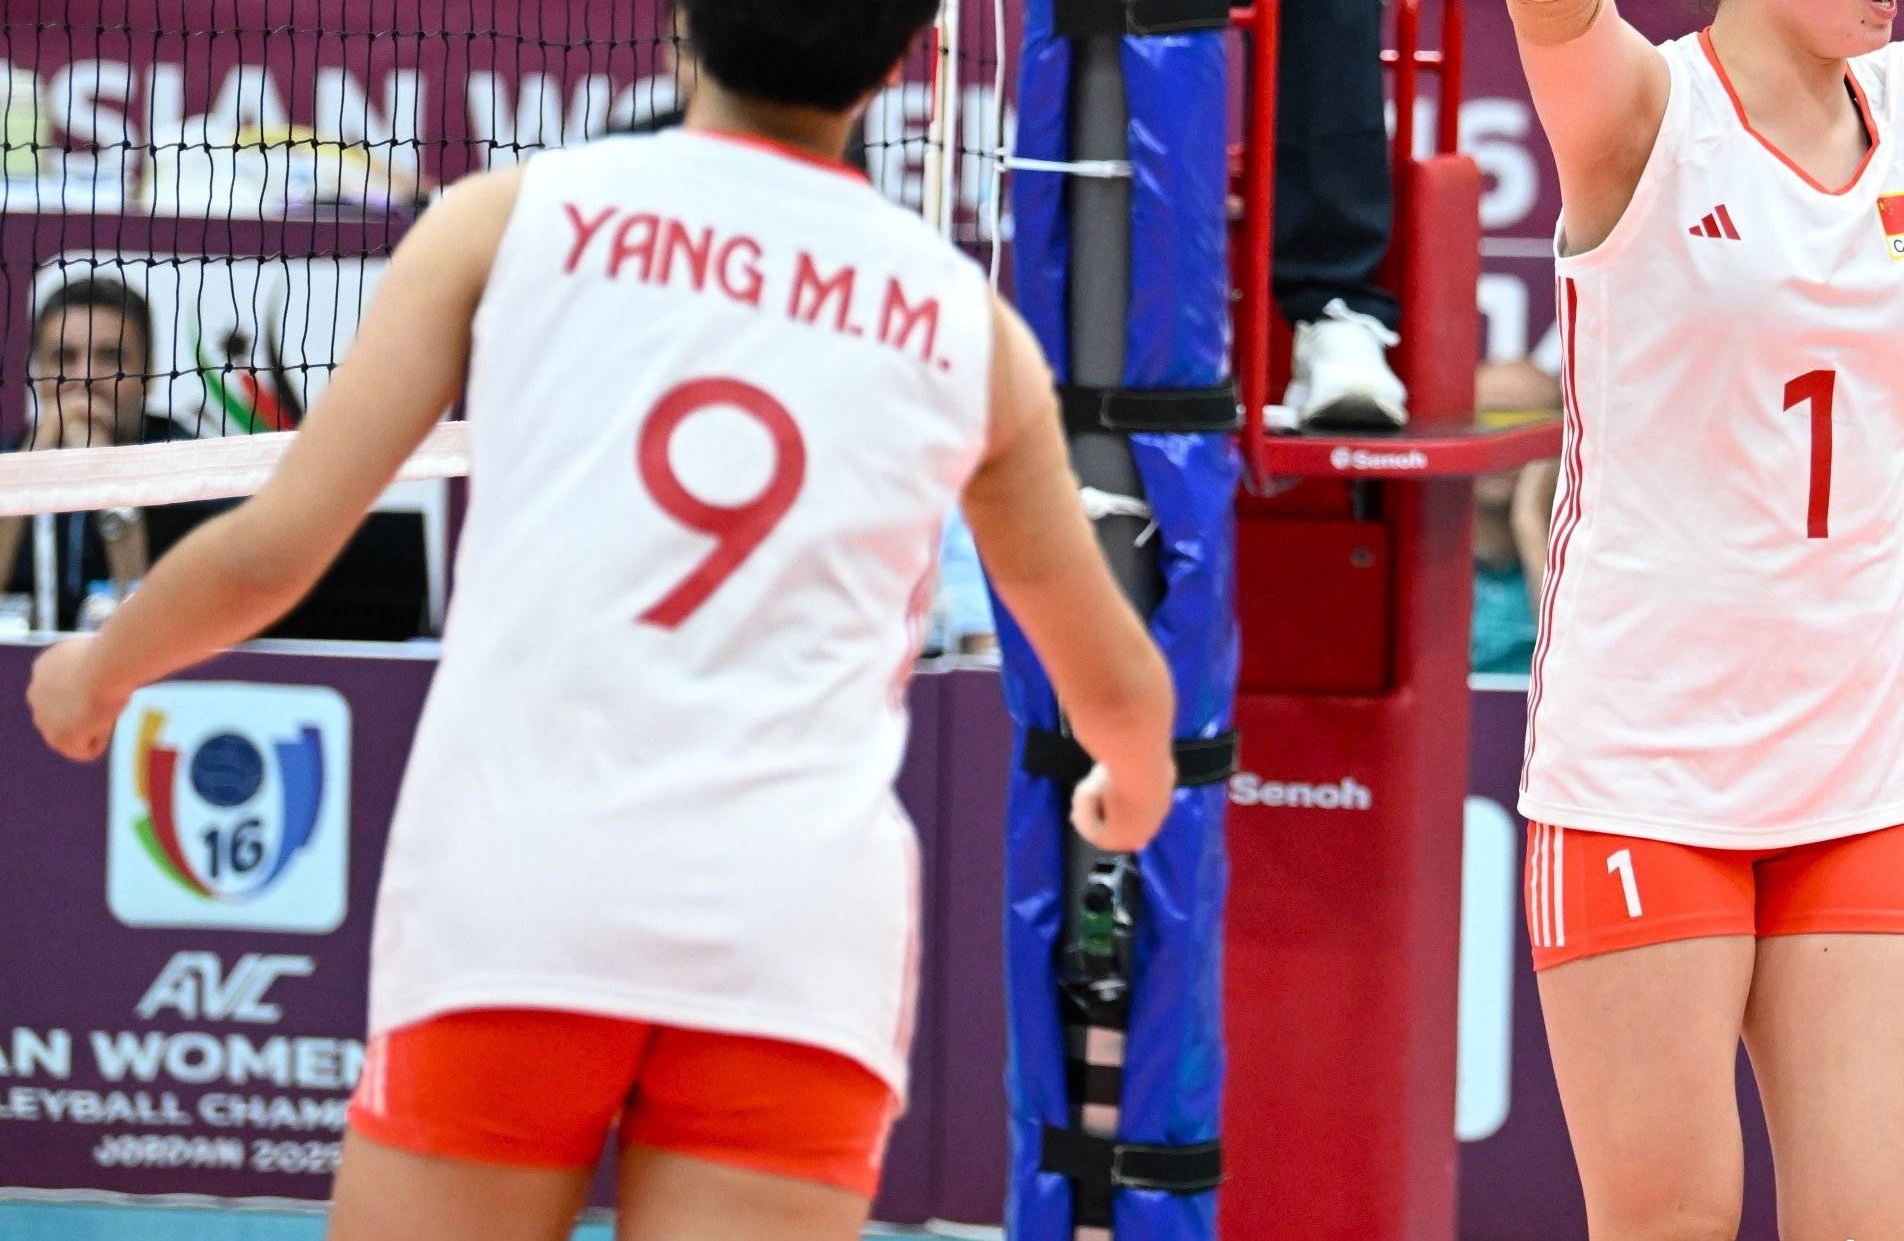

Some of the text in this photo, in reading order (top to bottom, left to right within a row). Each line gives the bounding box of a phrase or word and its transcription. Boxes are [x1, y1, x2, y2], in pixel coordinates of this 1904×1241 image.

[563, 203, 764, 308] YANG
[1783, 370, 1837, 539] 1
[635, 376, 807, 632] 9
[1228, 772, 1372, 810] Senoh
[200, 818, 265, 880] 16
[1606, 847, 1643, 919] 1
[135, 951, 317, 1025] AVC
